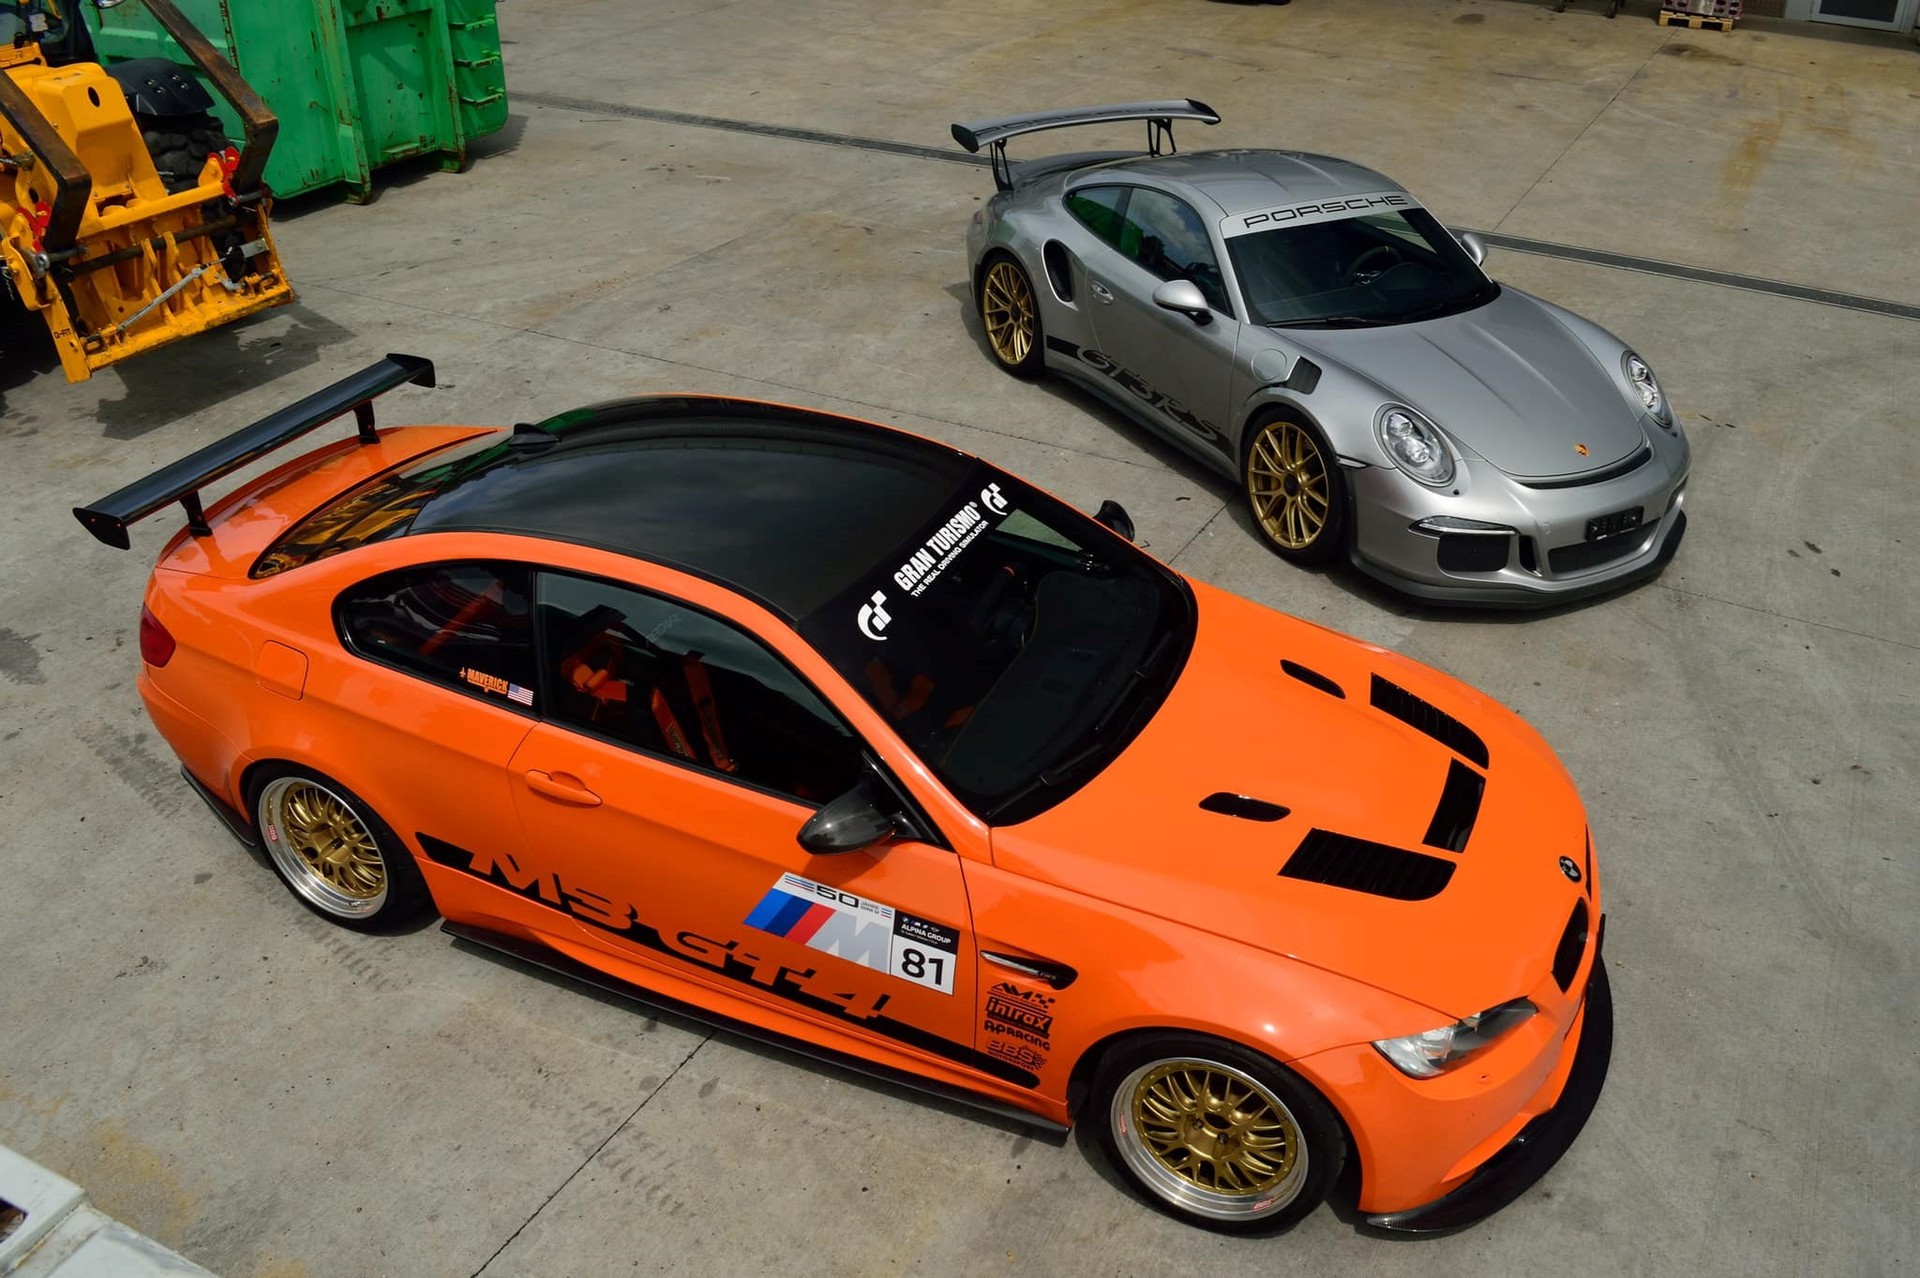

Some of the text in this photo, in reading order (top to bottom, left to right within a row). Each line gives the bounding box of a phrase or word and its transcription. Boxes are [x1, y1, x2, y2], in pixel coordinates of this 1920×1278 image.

[1243, 195, 1408, 229] PORSCHE
[893, 502, 981, 591] GRAN TURISMO
[911, 520, 989, 598] THE REAL DRIVING SIMULATOR
[467, 668, 509, 693] MAVERICK
[468, 848, 638, 931] M3
[816, 884, 859, 909] 50
[901, 923, 927, 937] ALPINA
[927, 931, 951, 944] GROUP
[657, 929, 892, 1021] GT4
[901, 948, 945, 986] 81
[1006, 1027, 1050, 1052] RACING
